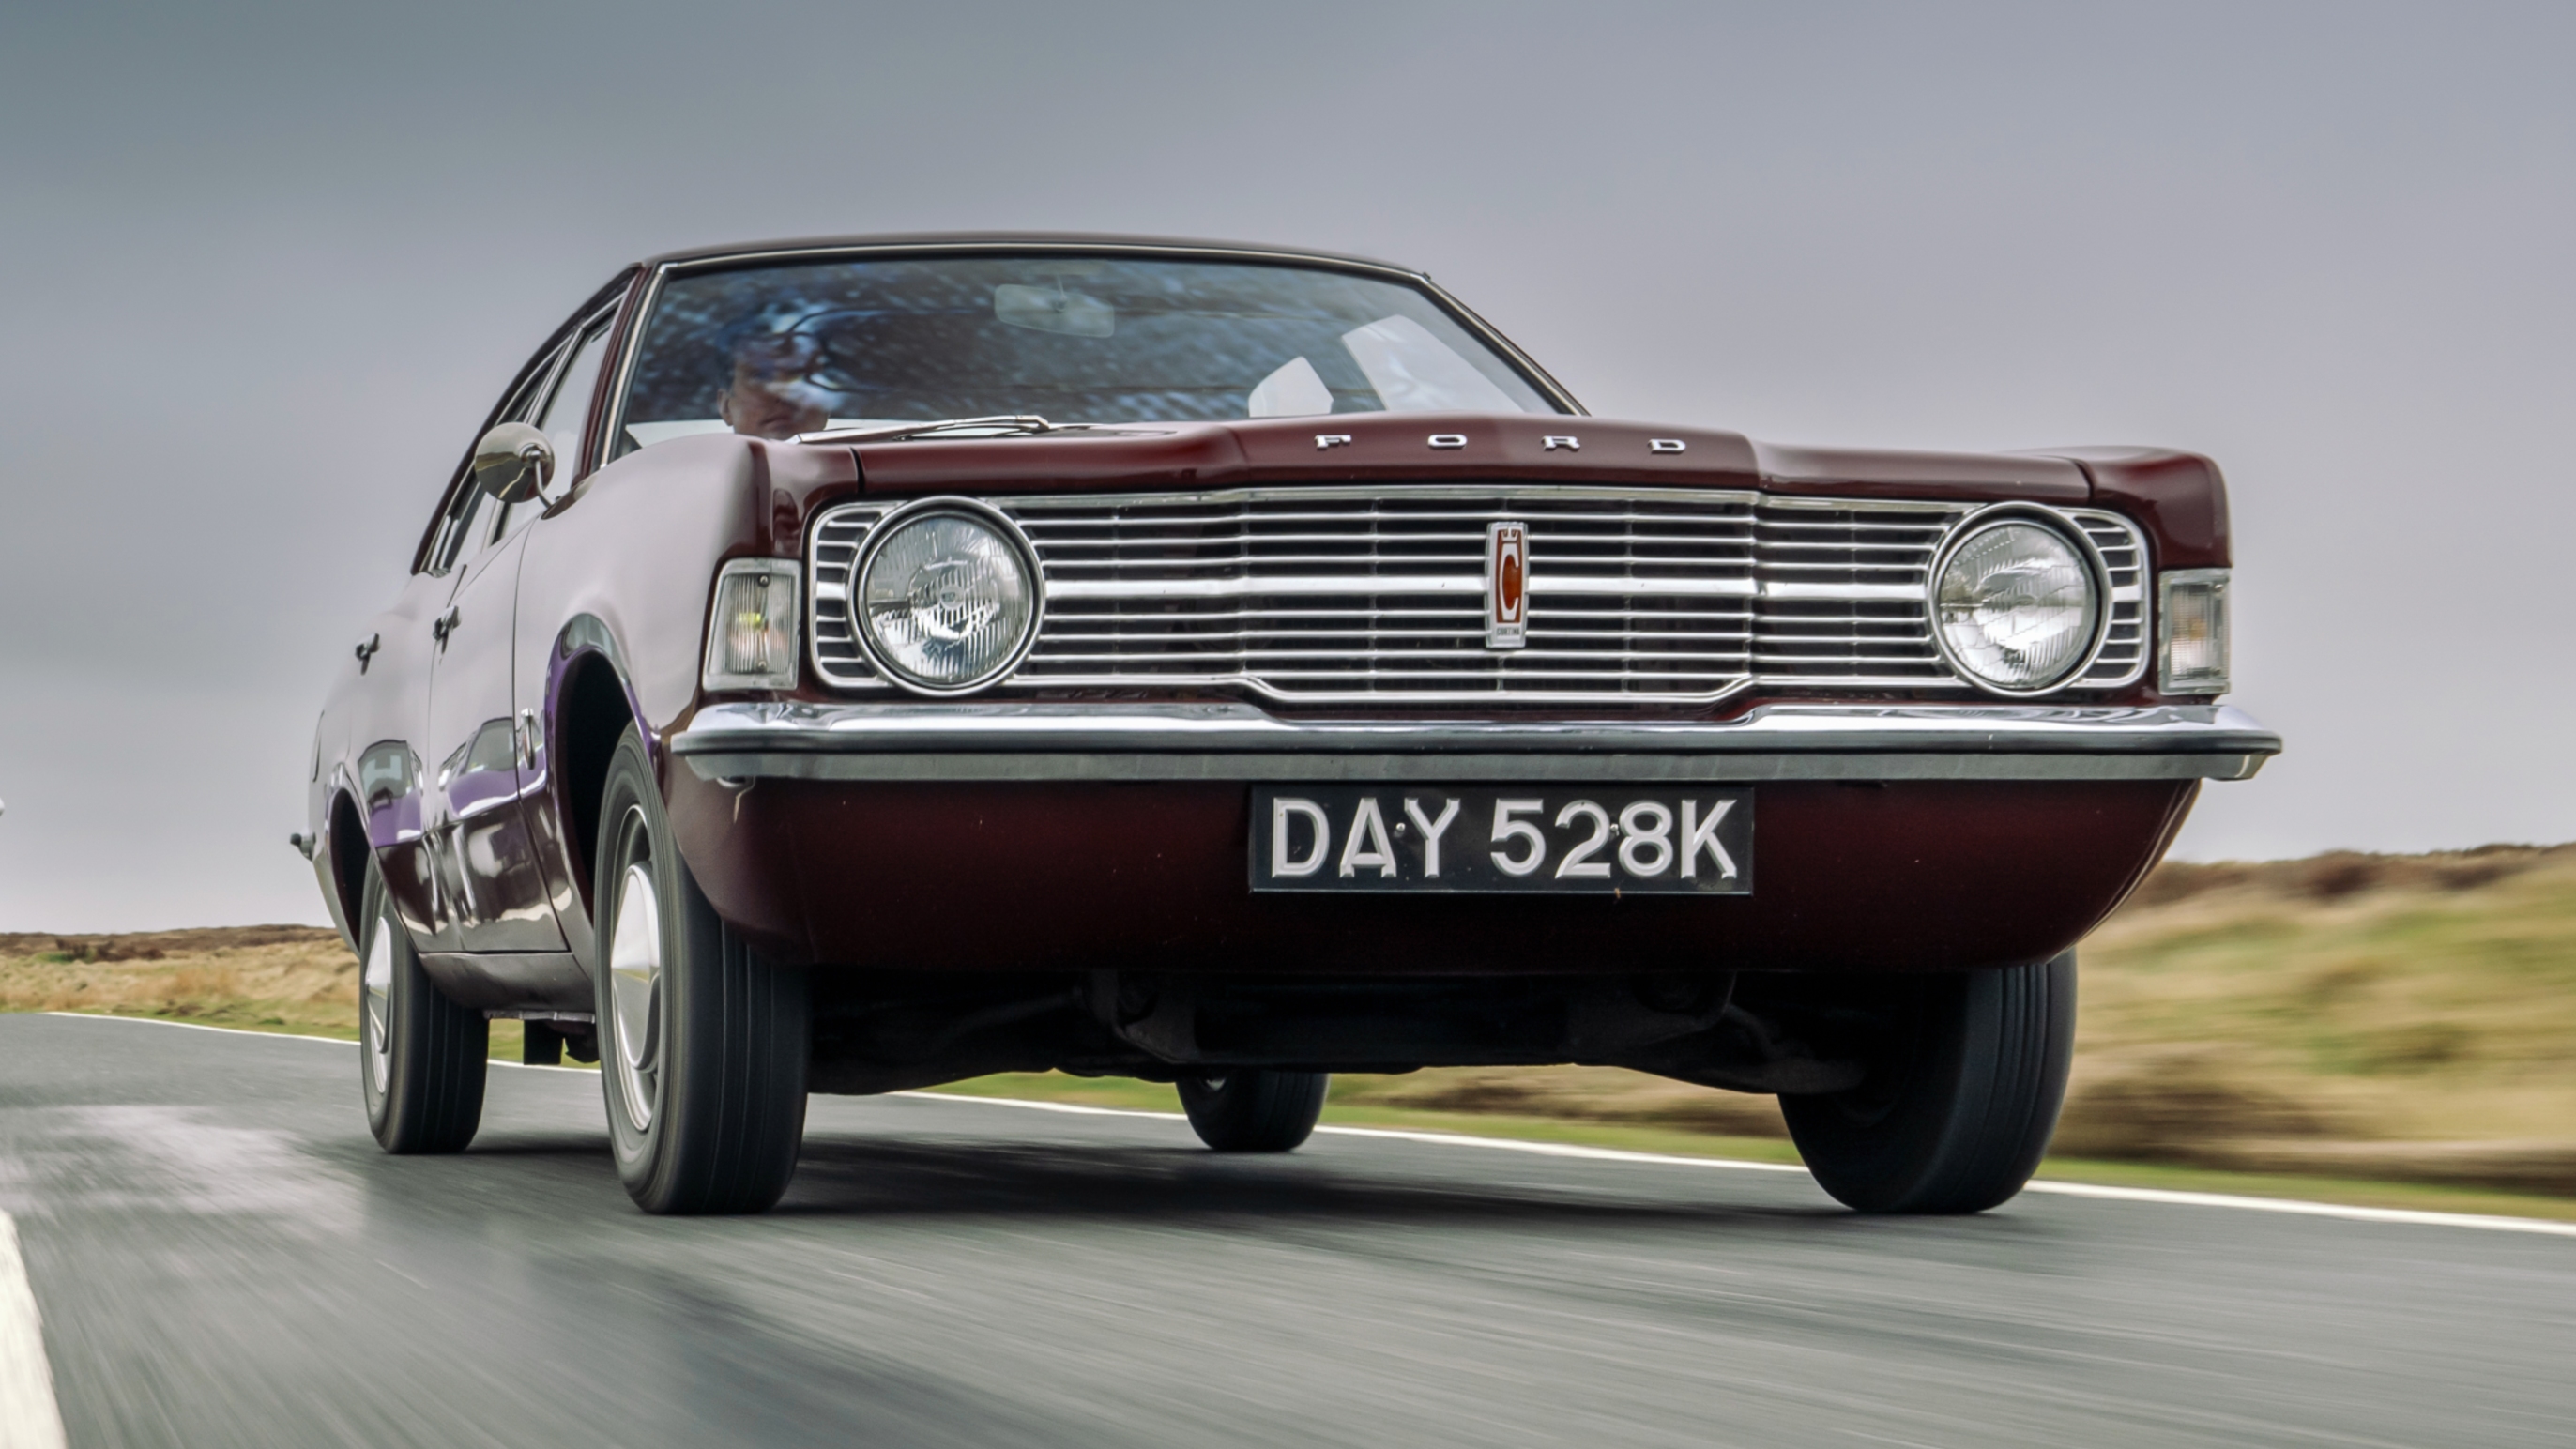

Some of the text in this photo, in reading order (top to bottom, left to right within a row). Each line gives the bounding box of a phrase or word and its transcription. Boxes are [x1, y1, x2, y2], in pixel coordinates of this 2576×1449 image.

[1315, 434, 1686, 454] FORD
[1272, 797, 1738, 880] DAY 528K
